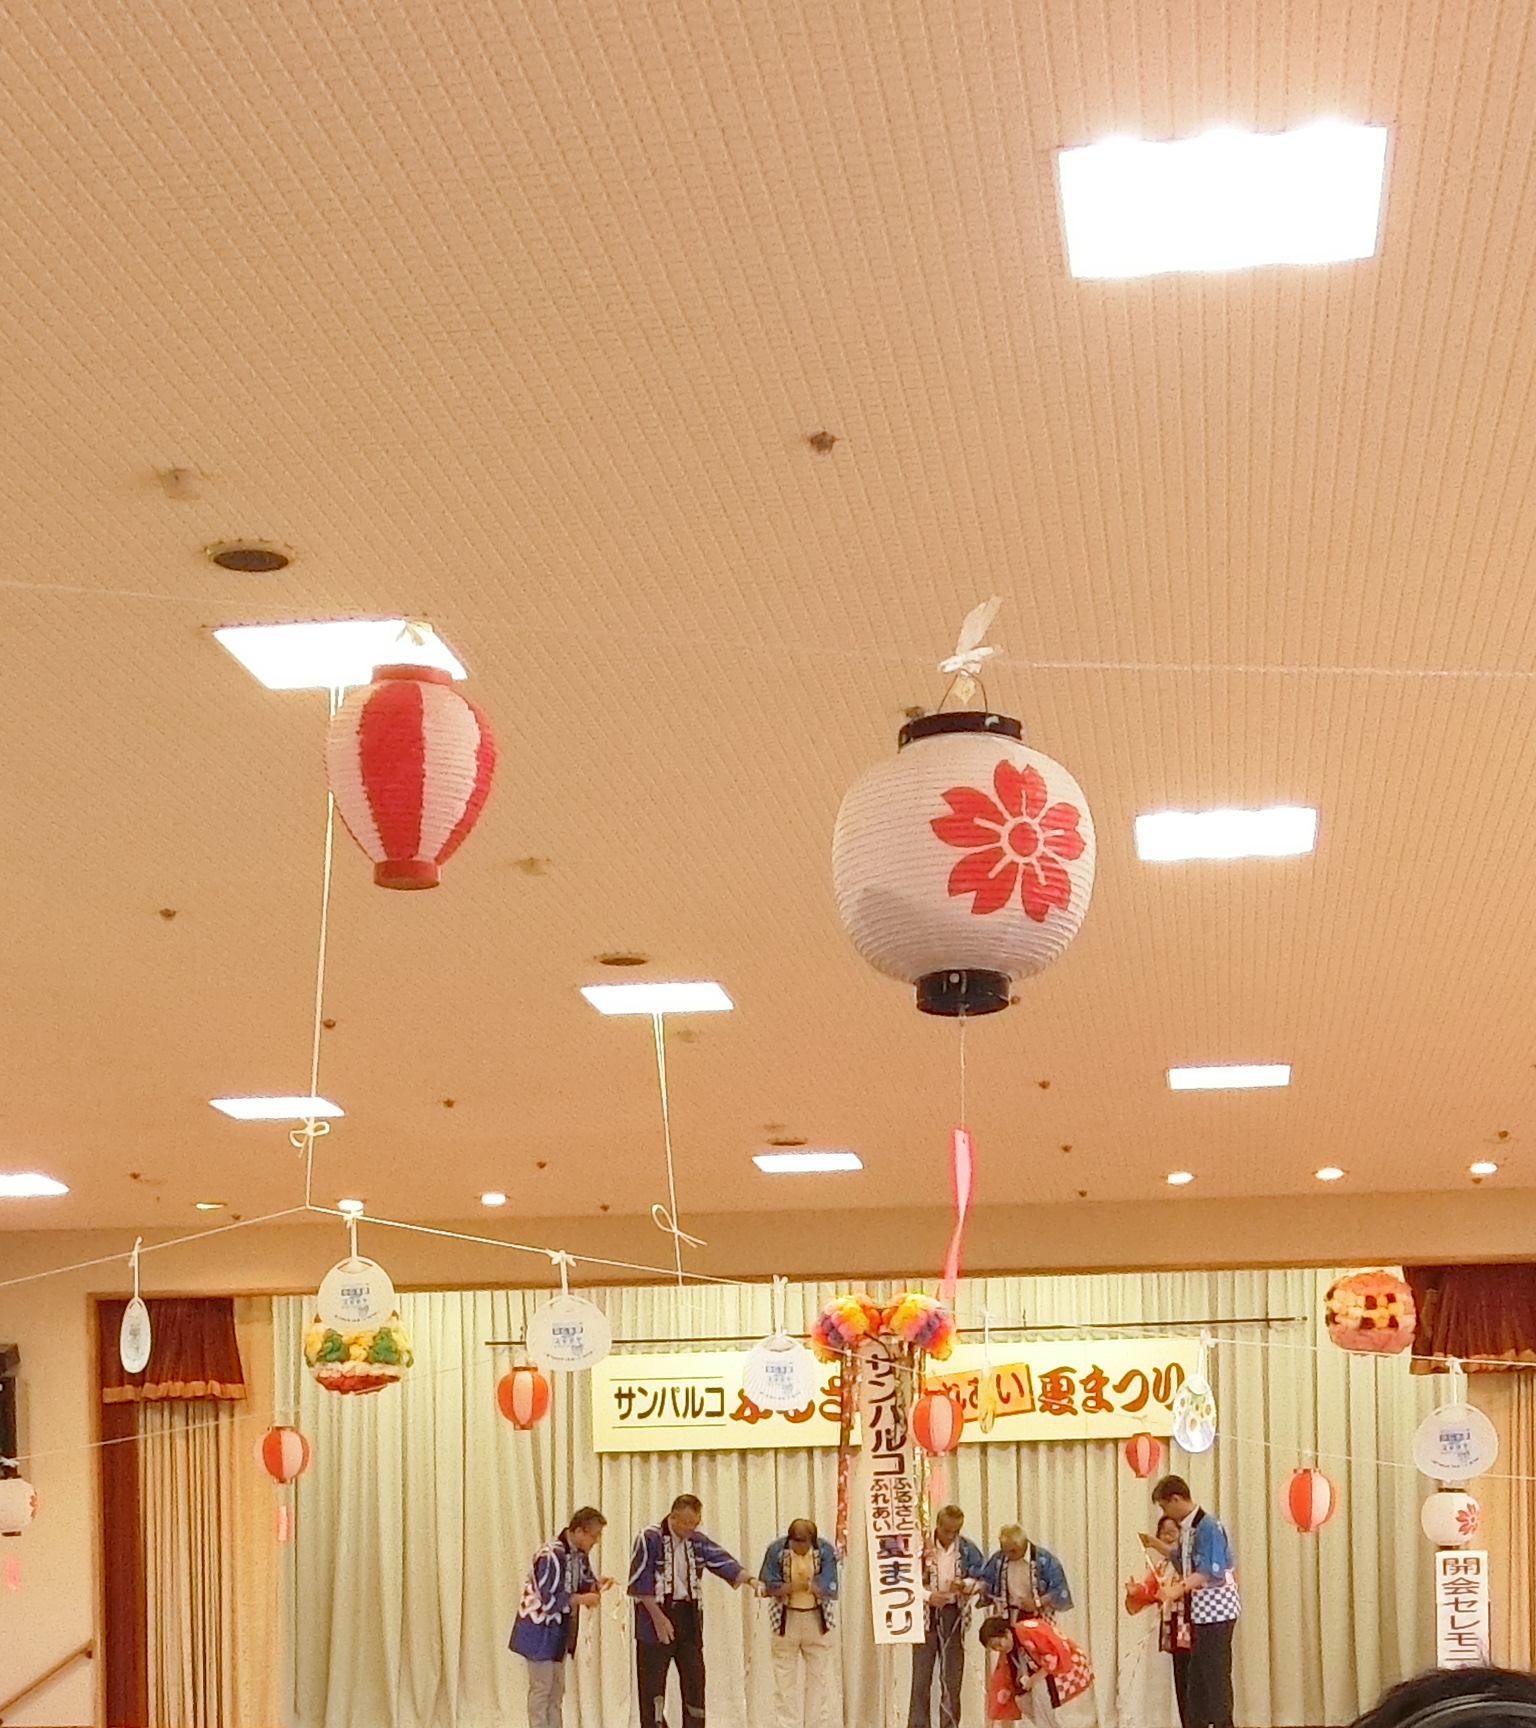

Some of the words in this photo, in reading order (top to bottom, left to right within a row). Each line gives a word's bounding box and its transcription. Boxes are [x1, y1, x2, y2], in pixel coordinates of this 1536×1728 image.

[614, 1385, 725, 1420] サンパルコ
[870, 1478, 891, 1532] ふれあい
[1441, 1557, 1481, 1663] 開会セレモニ
